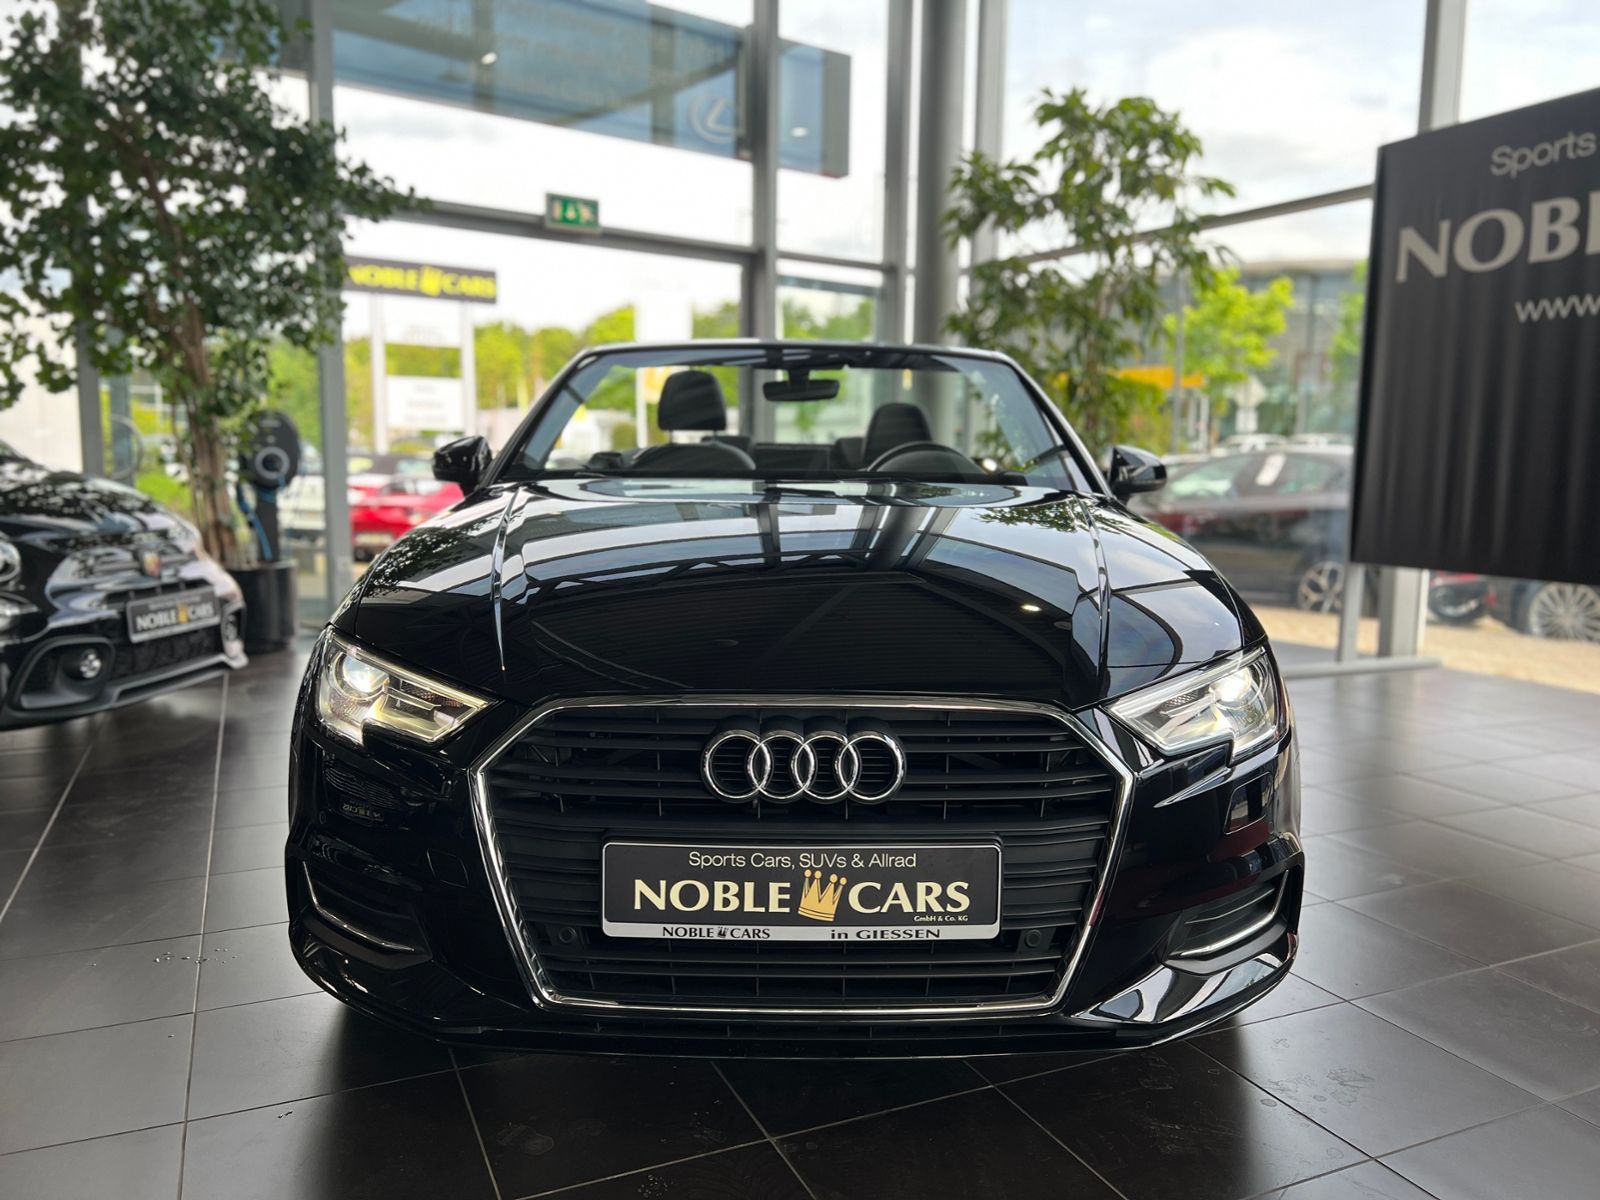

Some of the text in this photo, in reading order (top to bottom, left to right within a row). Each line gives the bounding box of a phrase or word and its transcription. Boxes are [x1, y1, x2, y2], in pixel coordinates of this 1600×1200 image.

[1490, 131, 1596, 178] Sports
[688, 851, 917, 869] Sports Cars, SUVs & Allrad
[633, 879, 971, 913] NOBLE CARS
[662, 926, 941, 940] NOBLE CARS in GIESSEN
